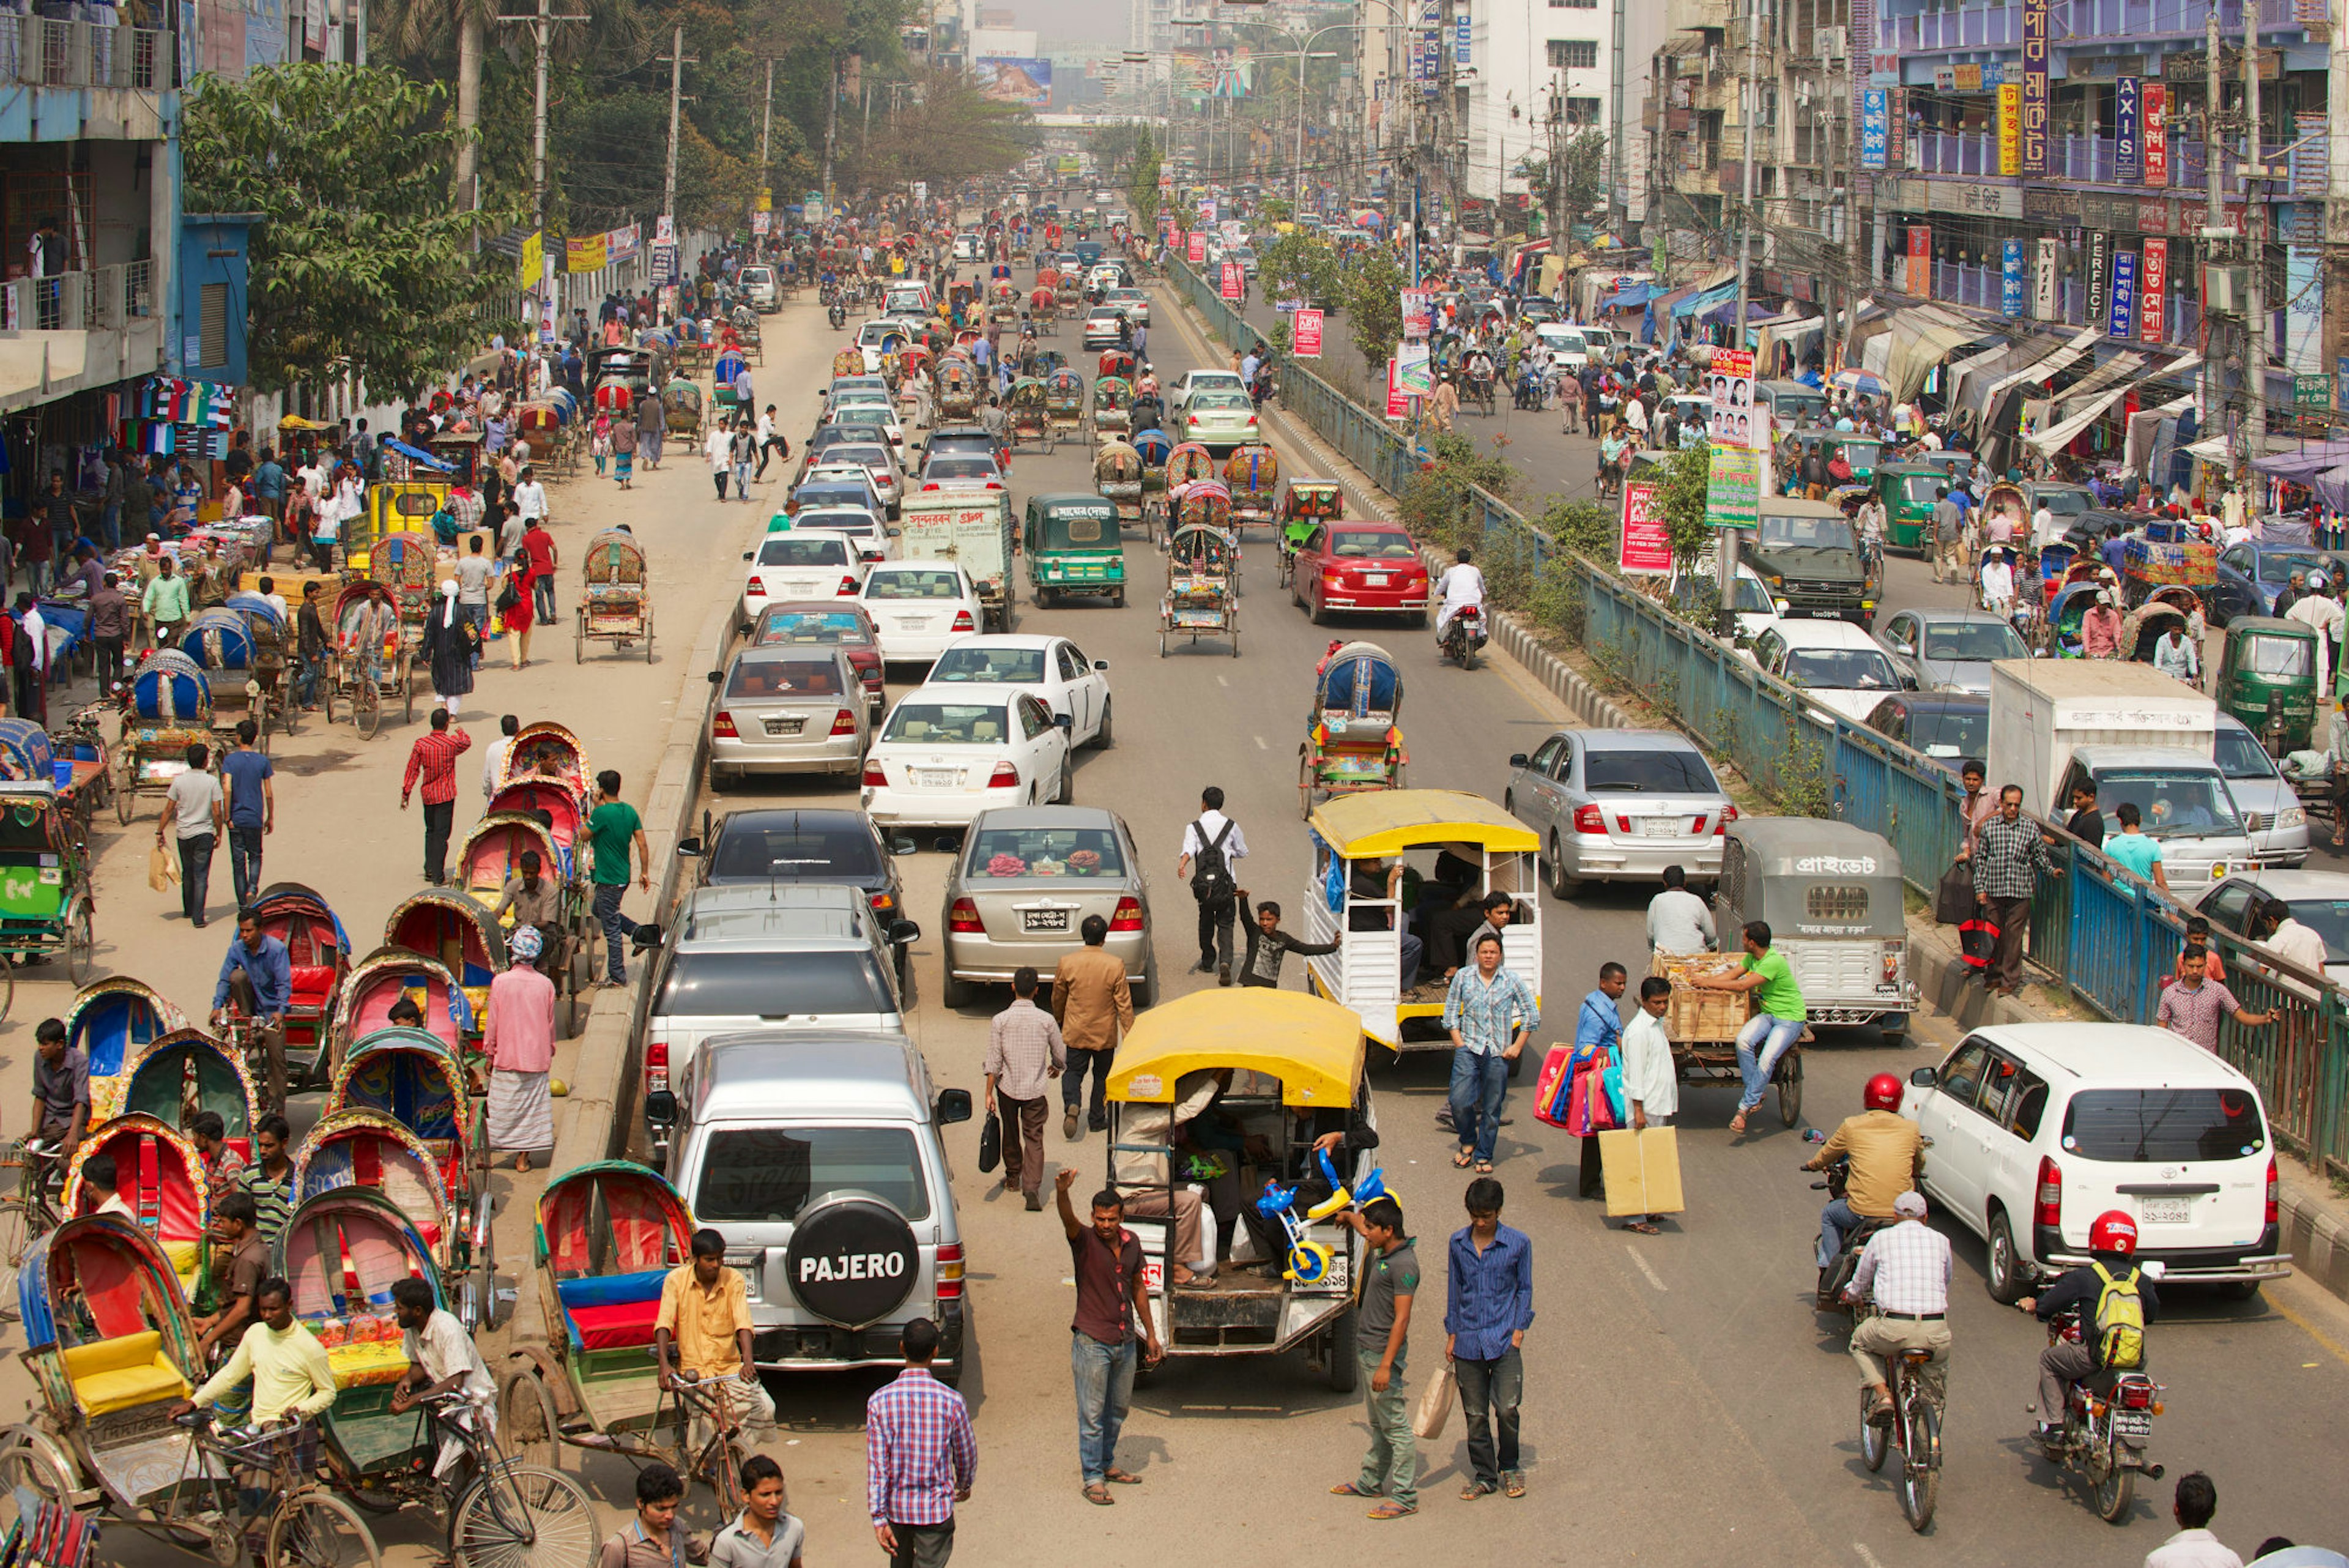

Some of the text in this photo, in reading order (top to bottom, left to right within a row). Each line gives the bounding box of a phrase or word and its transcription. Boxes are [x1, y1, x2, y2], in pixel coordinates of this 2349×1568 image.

[1892, 89, 1903, 160] BIG BAZAR
[2119, 79, 2135, 154] AXIS
[2039, 264, 2054, 301] File
[2090, 233, 2103, 318] PERFECT
[2116, 255, 2132, 302] রাজশাহী
[2146, 252, 2162, 288] তাঁত
[2143, 292, 2162, 328] মেলা
[1712, 348, 1732, 361] UCC
[1058, 507, 1110, 517] মায়ের দোয়া
[1797, 856, 1876, 874] প্রাইভেট
[800, 1251, 905, 1282] PAJERO
